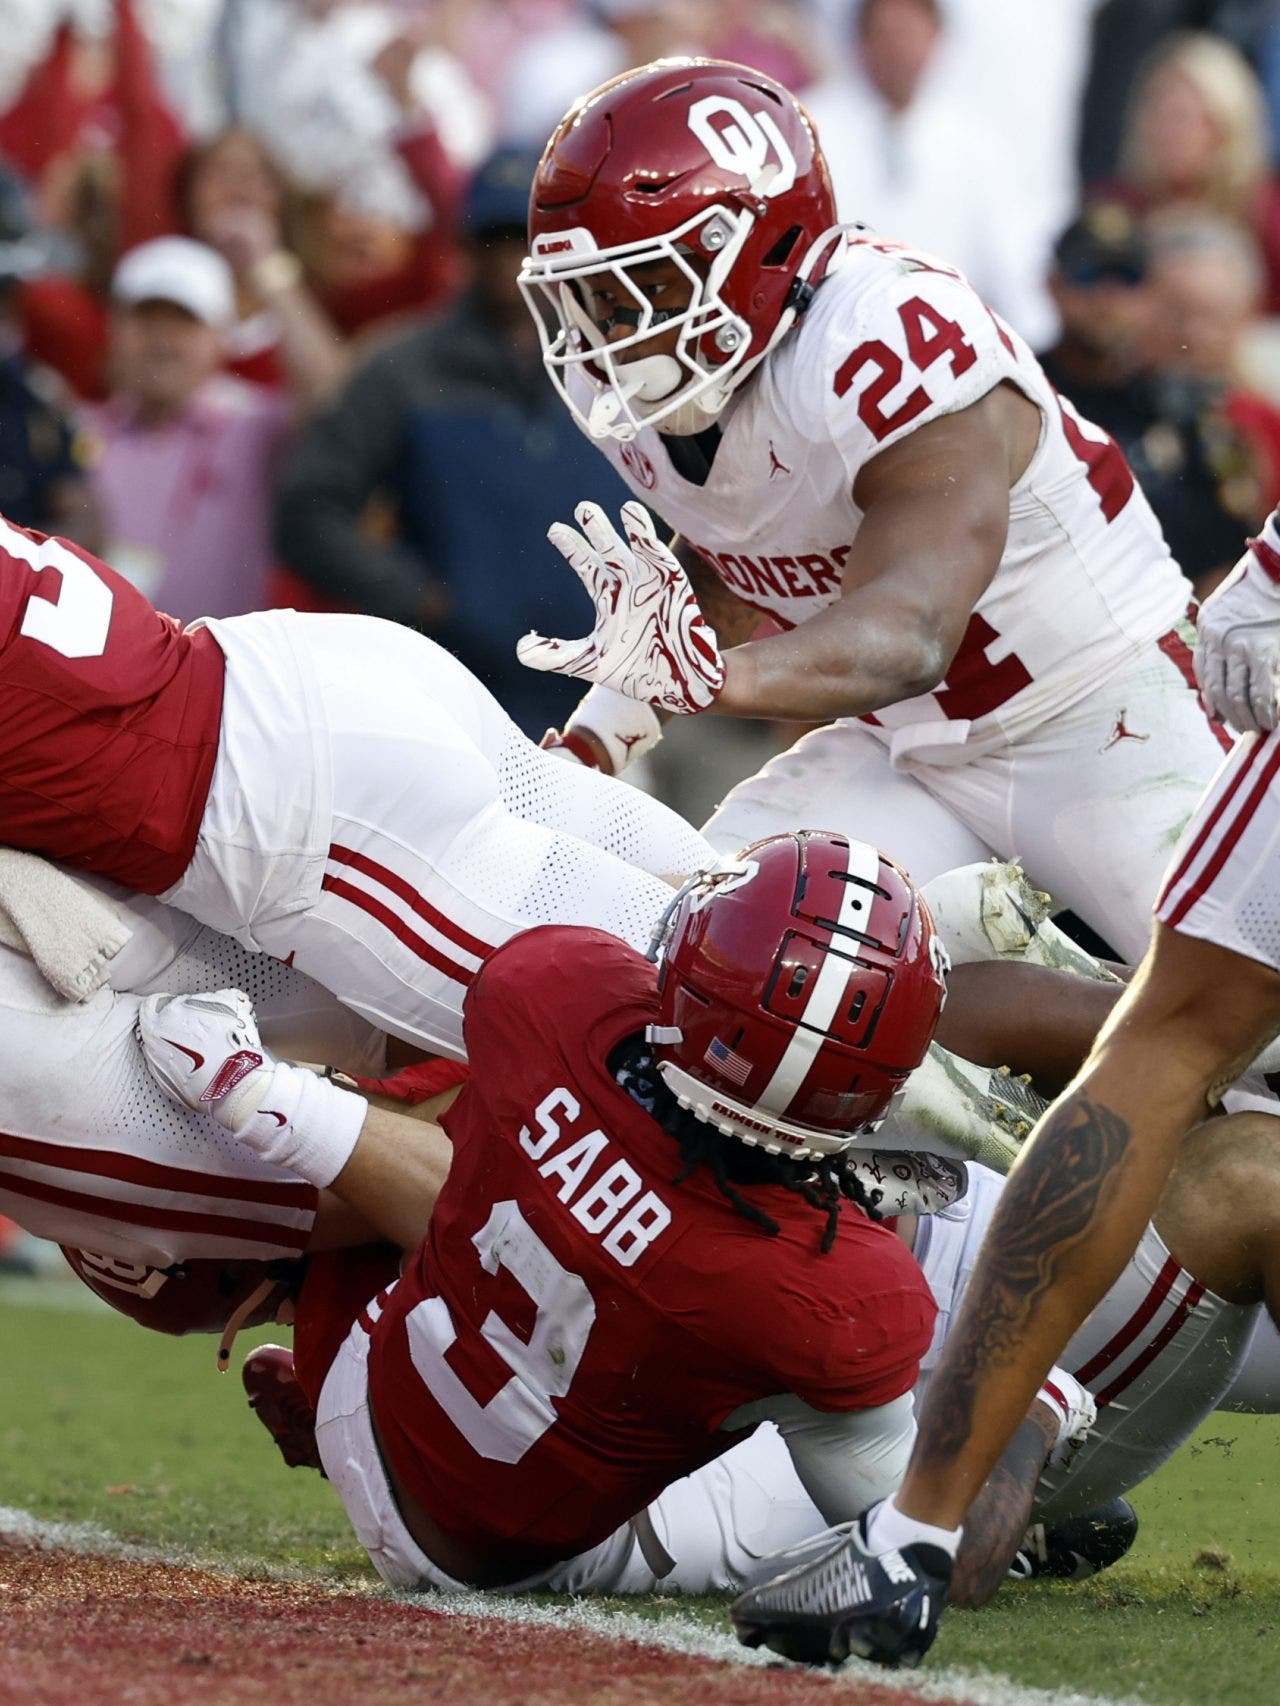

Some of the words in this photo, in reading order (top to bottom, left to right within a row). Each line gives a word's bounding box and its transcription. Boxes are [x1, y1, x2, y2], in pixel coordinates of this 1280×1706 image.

[687, 95, 797, 198] OU
[833, 296, 978, 443] 24
[519, 1087, 673, 1268] SABB
[405, 1199, 597, 1465] 3
